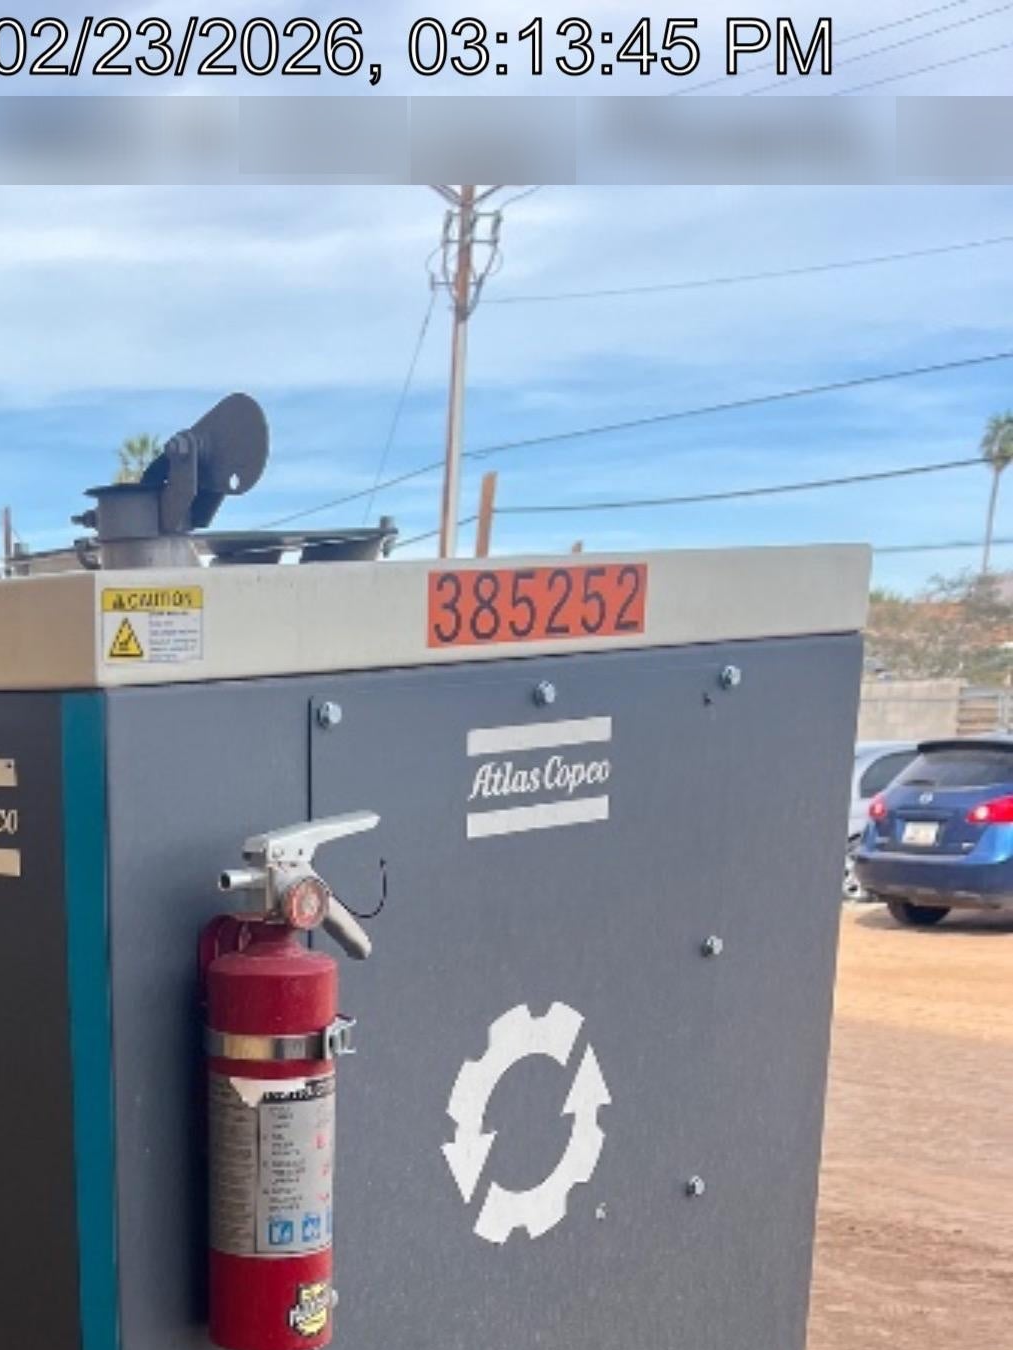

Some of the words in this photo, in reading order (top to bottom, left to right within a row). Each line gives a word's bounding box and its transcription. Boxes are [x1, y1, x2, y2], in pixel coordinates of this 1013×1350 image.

[433, 565, 642, 643] 385252
[468, 761, 540, 801] Atlas
[544, 755, 611, 795] Copco
